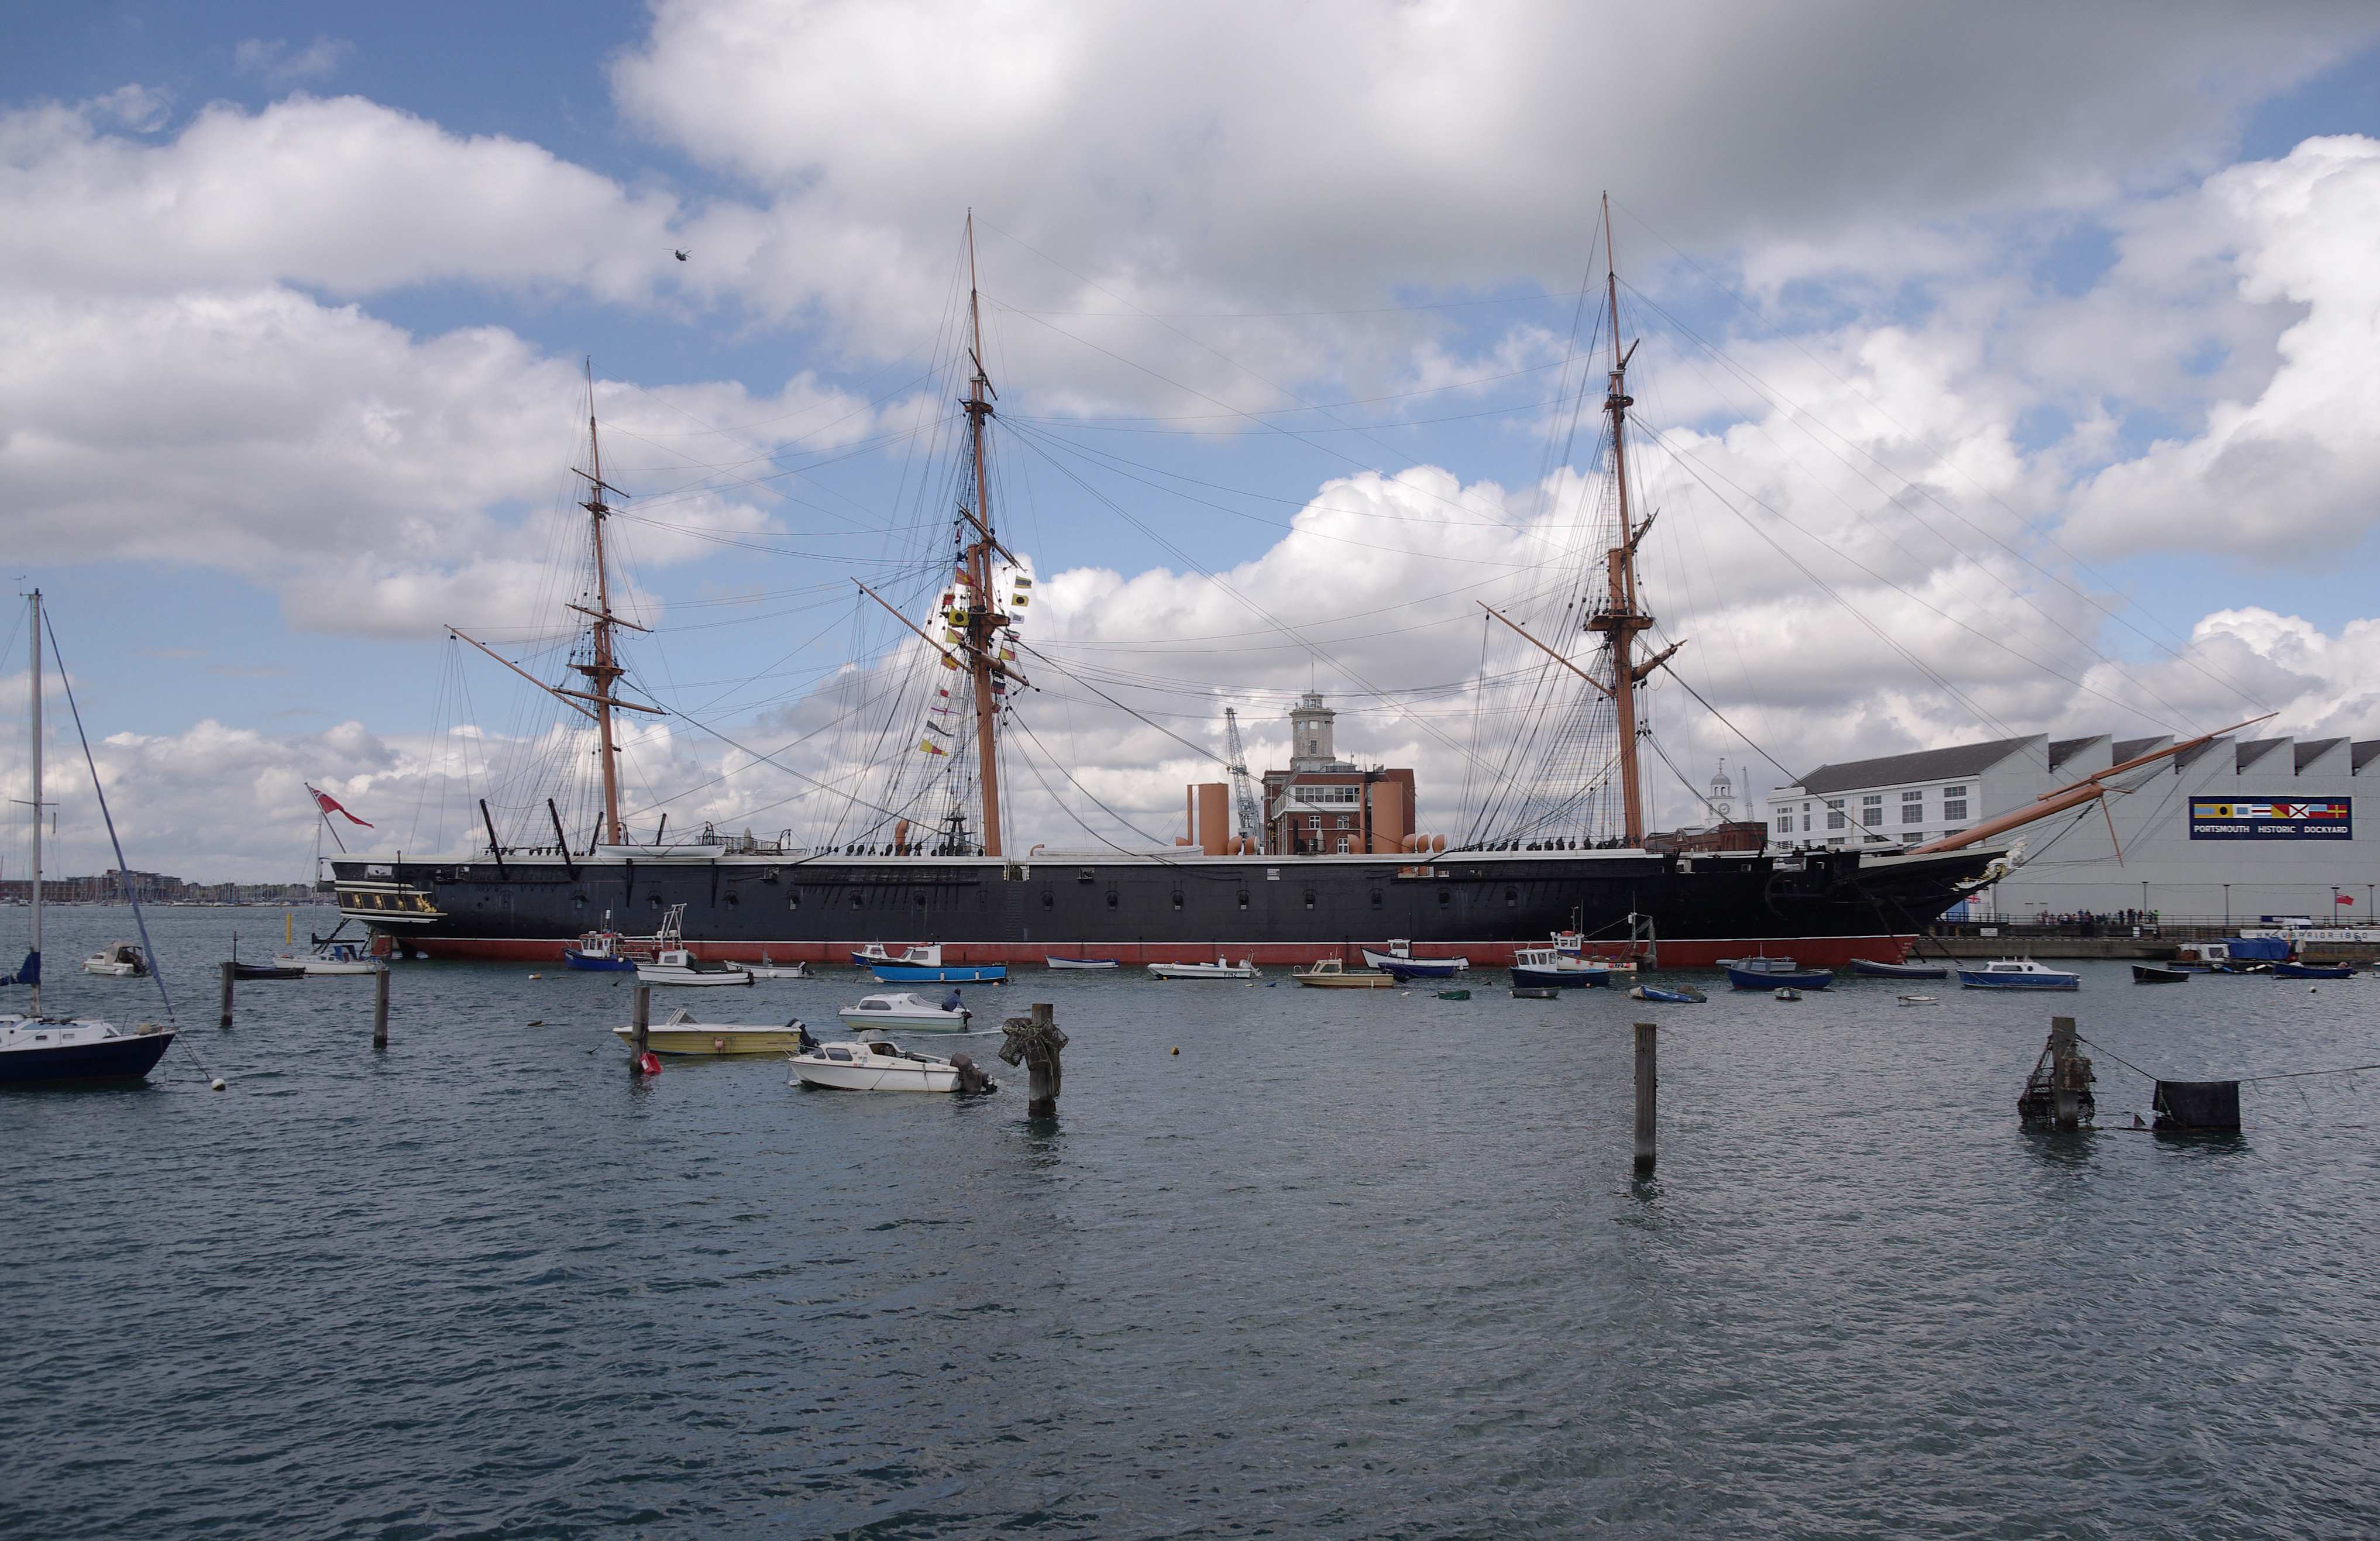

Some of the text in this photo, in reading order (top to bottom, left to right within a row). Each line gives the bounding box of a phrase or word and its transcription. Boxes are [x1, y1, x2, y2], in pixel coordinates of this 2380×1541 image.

[2193, 825, 2349, 834] PORTSMOUTH HISTORIC DOCKYARD
